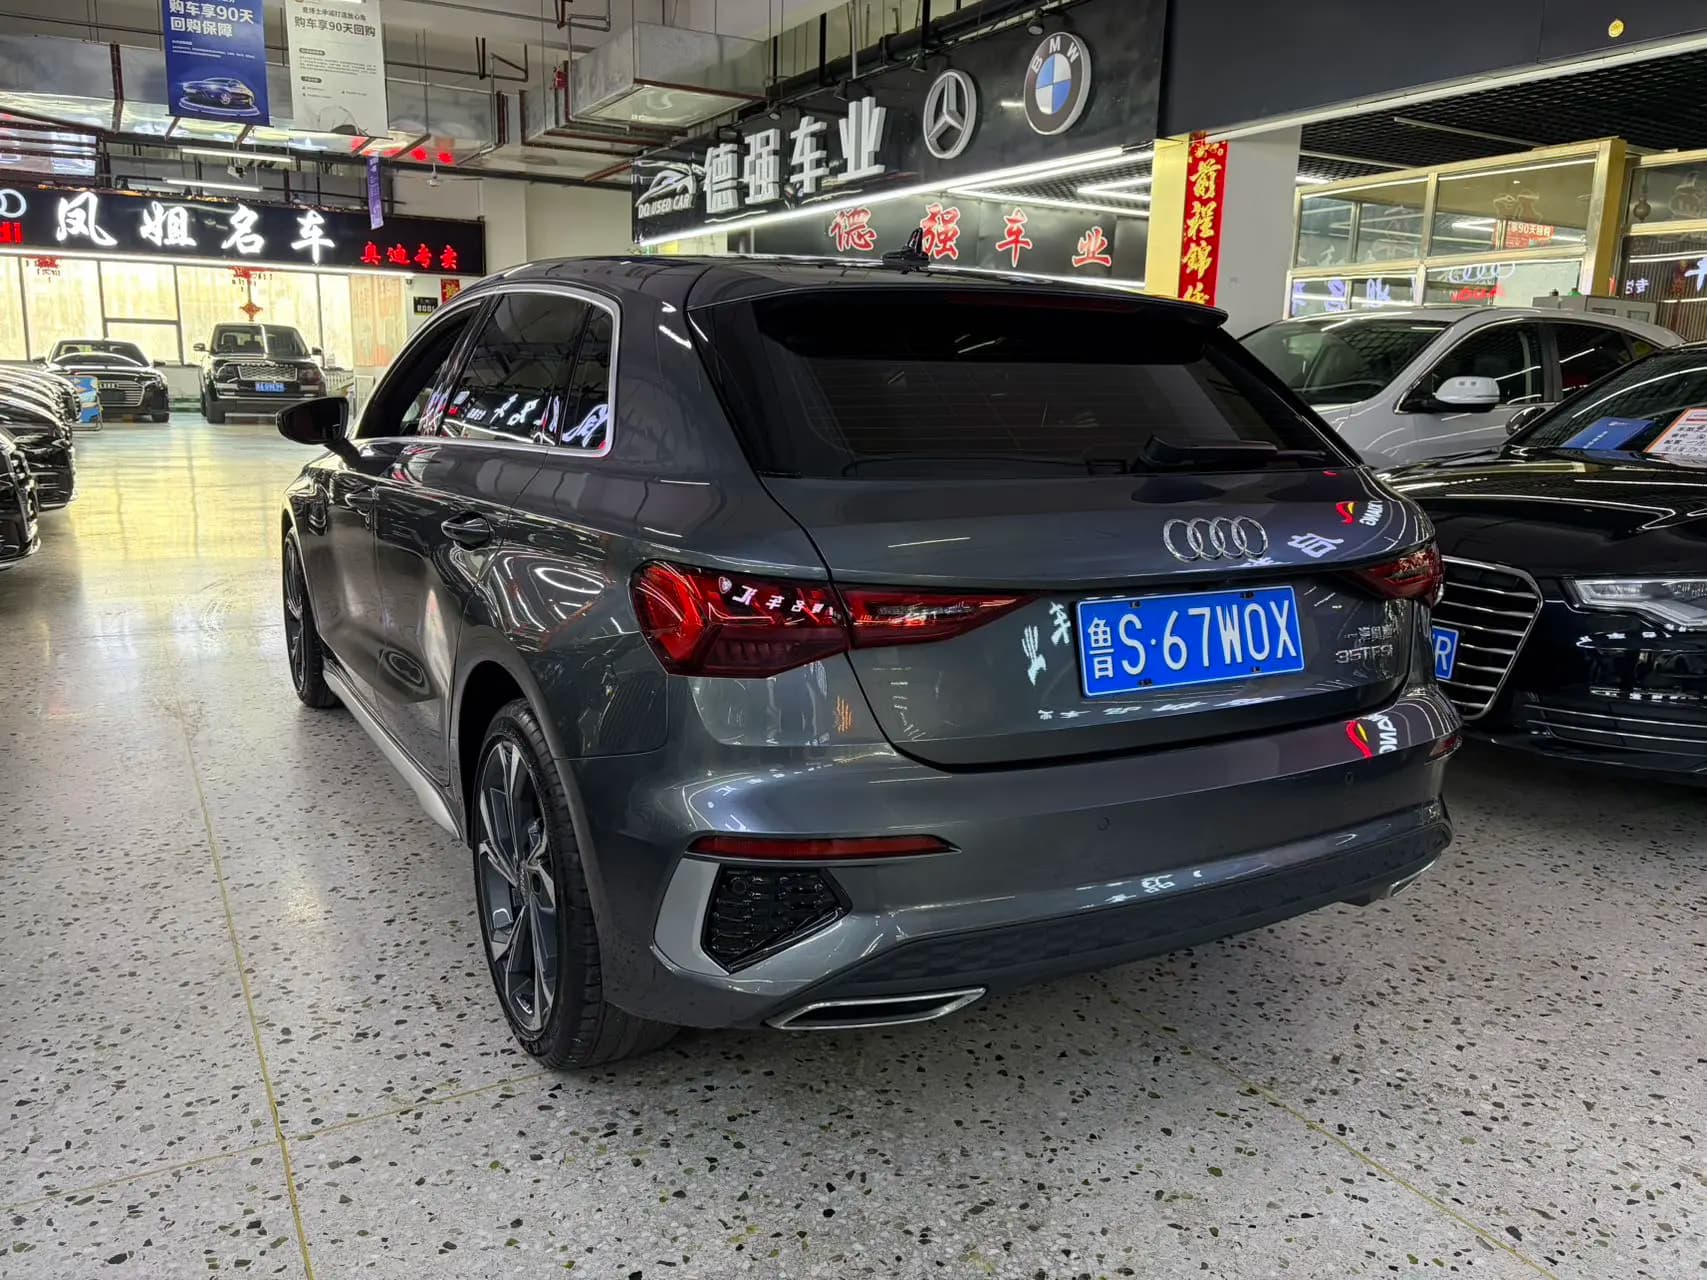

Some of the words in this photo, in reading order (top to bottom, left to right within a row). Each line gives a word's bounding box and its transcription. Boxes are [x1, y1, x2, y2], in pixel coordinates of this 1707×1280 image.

[169, 0, 254, 24] 购车享90天
[170, 17, 233, 37] 回购保障
[294, 16, 377, 37] 购车享90天回购
[1031, 35, 1080, 74] BMW
[702, 96, 888, 214] 德强车业
[55, 191, 336, 265] 凤姐名车
[829, 203, 1112, 269] 德强车业
[360, 241, 458, 270] 奥迪专卖
